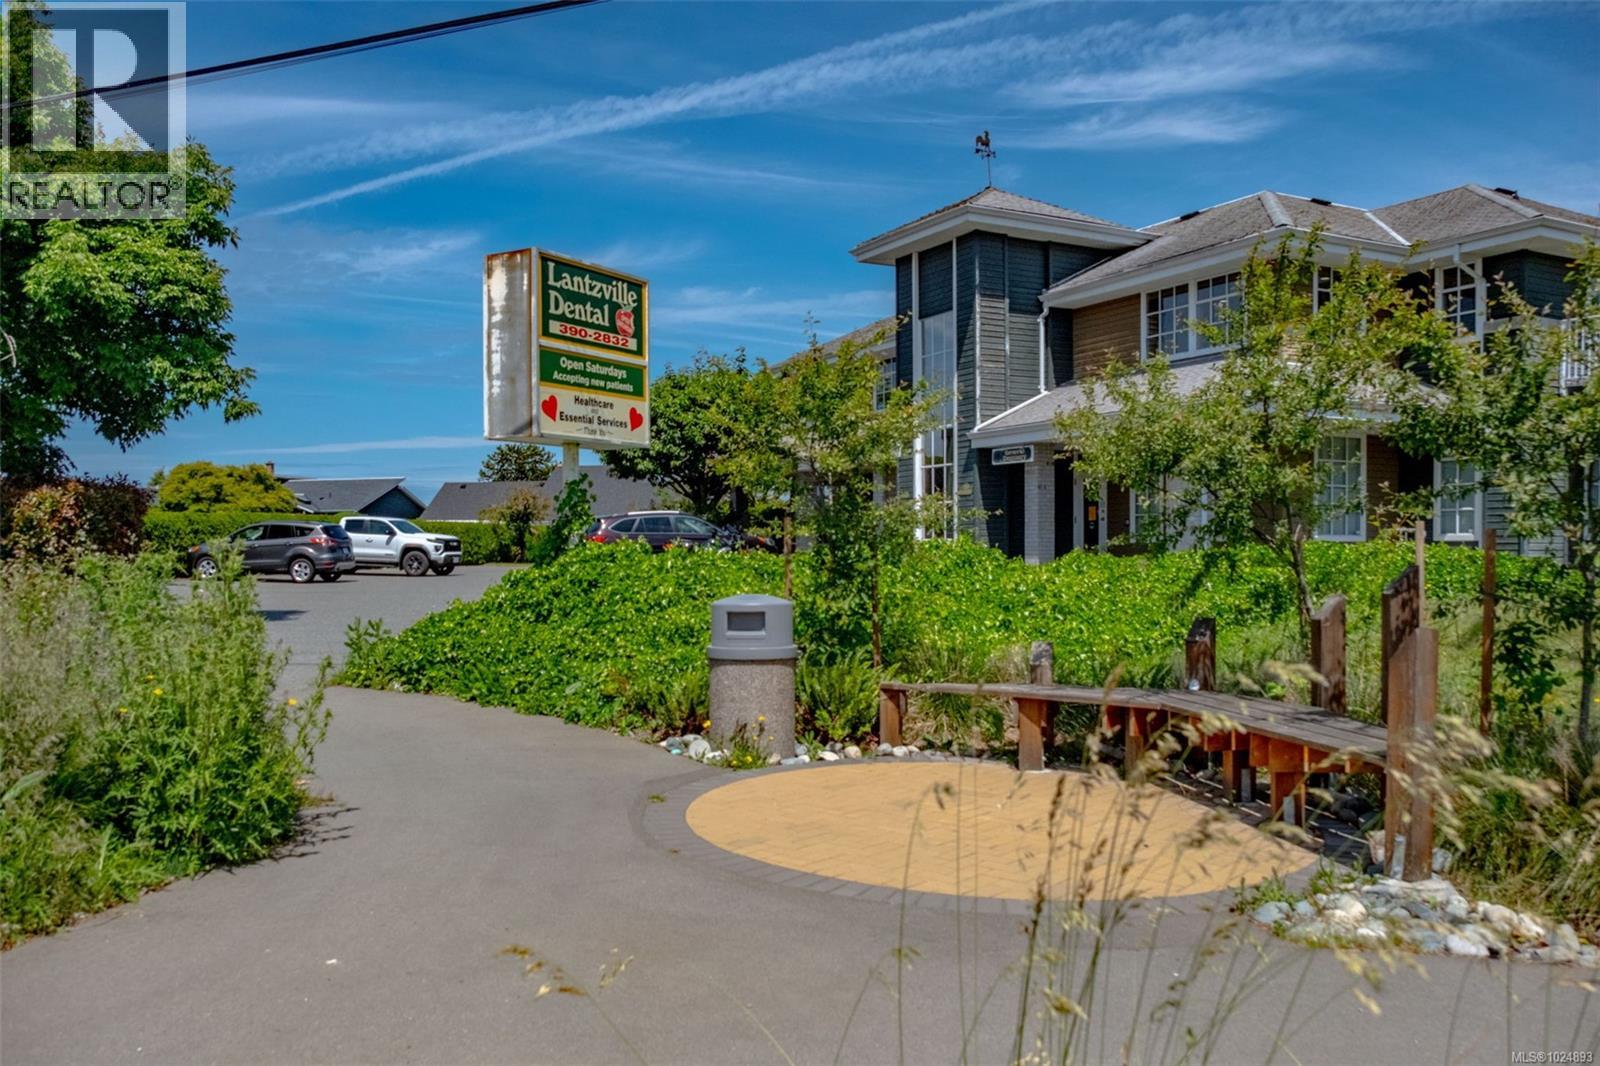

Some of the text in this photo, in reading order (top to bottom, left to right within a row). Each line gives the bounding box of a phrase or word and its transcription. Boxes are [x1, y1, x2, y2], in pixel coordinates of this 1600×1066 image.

[547, 261, 638, 308] Lantzville
[548, 289, 610, 327] Dental
[559, 324, 629, 347] 390-2832
[560, 356, 627, 379] Open Saturdays
[553, 370, 634, 392] Accepting new patients
[574, 395, 614, 410] Healthcare
[559, 411, 595, 425] Essential
[597, 415, 628, 429] Services
